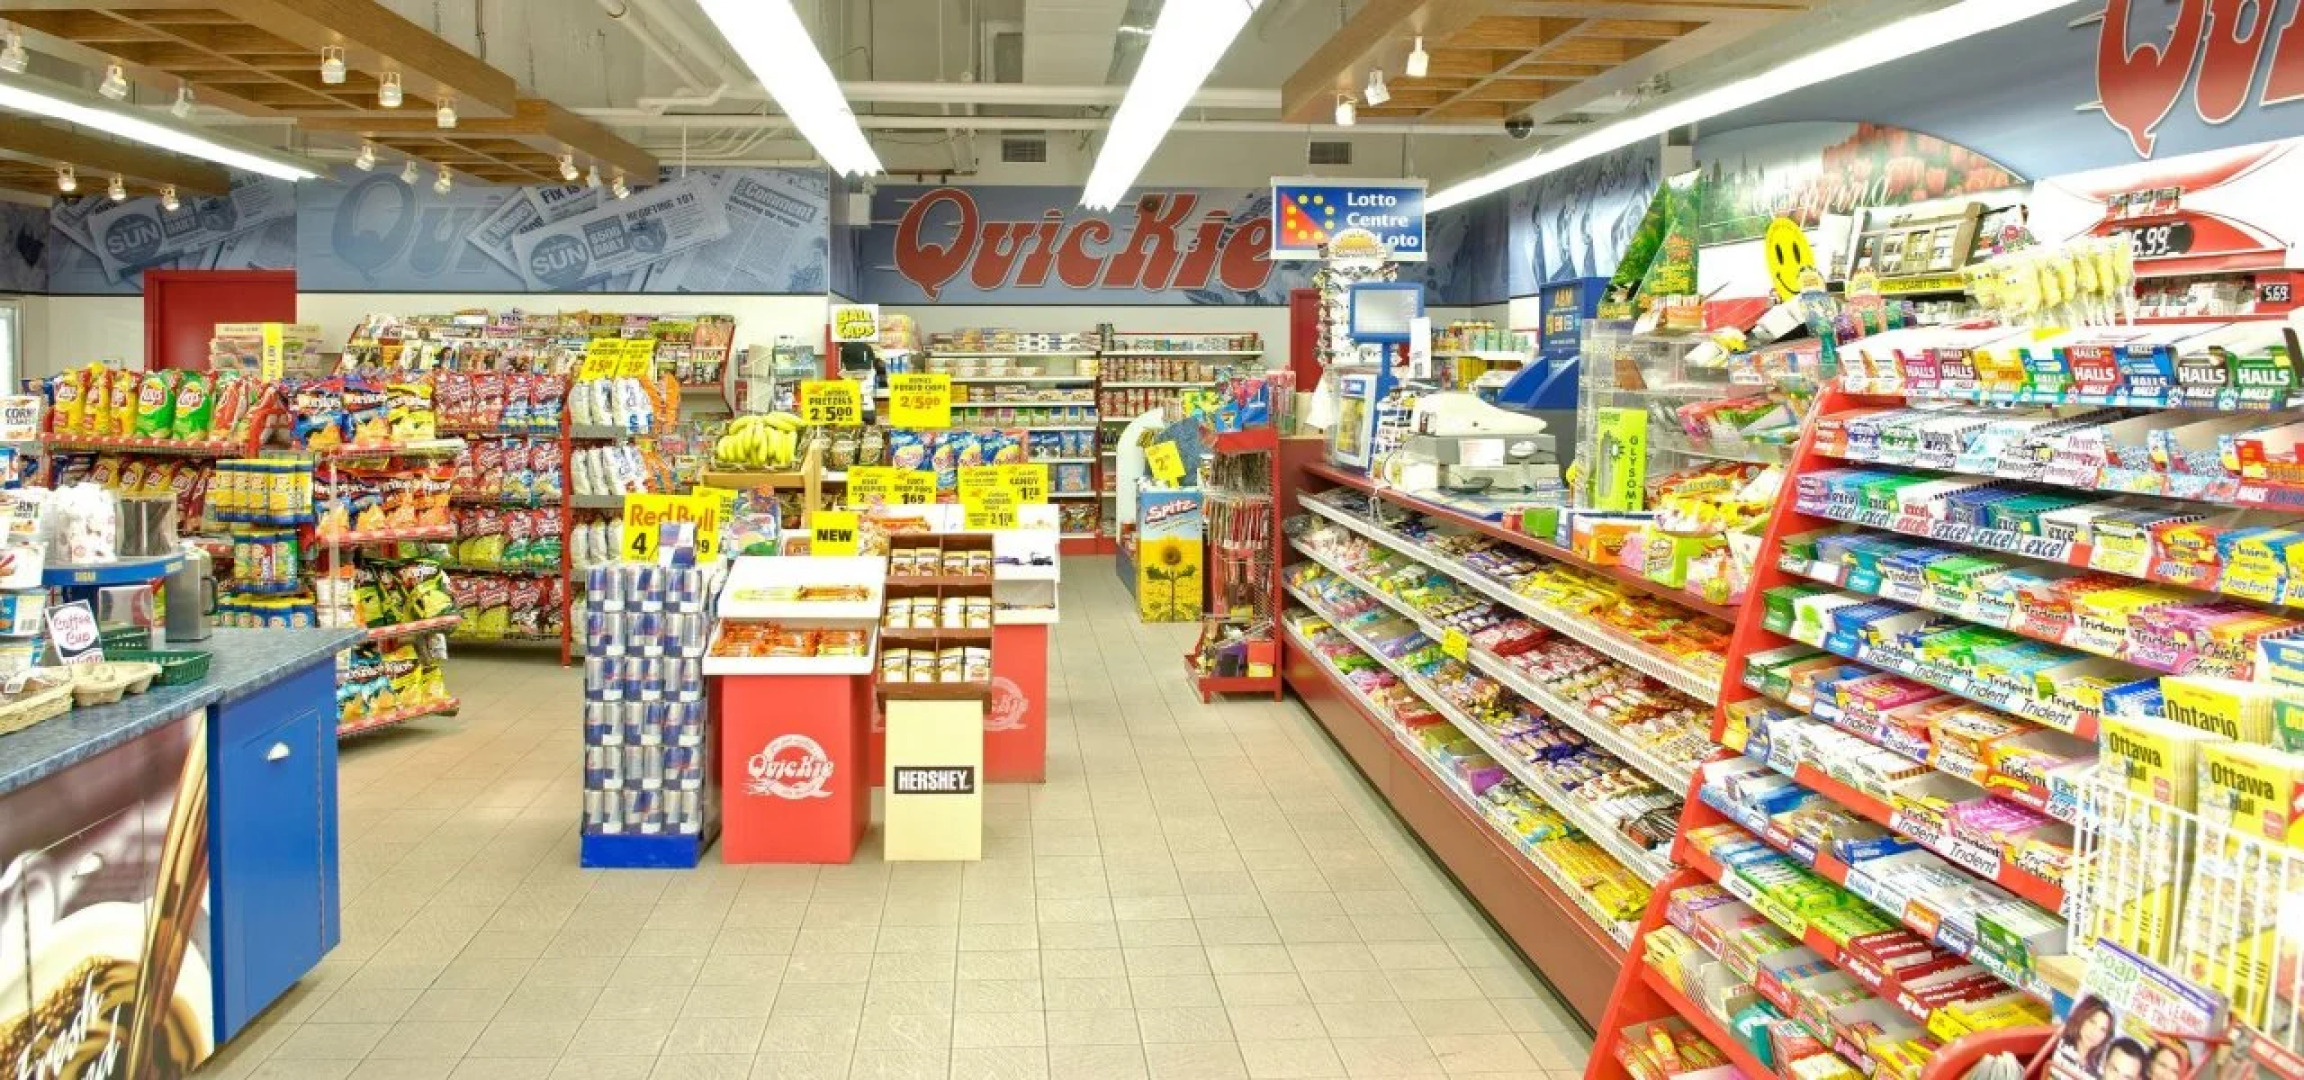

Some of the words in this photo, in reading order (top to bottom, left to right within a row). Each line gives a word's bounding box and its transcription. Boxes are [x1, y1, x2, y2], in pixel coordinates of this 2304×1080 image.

[1347, 192, 1398, 207] Lotto
[1346, 211, 1409, 228] Centre
[107, 224, 160, 252] SUN
[532, 243, 588, 275] SUN
[1906, 365, 1936, 379] HALLS
[1942, 365, 1974, 379] HALLS
[2074, 367, 2116, 381] HALLS
[2130, 377, 2167, 386] HALLS
[2178, 367, 2226, 384] HALLS
[2237, 368, 2290, 385] HALLS
[630, 503, 673, 527] Red
[1144, 498, 1198, 523] Spitz
[1828, 504, 1855, 518] excel
[1861, 511, 1891, 526] excel
[1903, 503, 1930, 517] excel
[816, 529, 853, 543] NEW
[1936, 524, 1971, 541] excel
[1979, 529, 2016, 550] excel
[2025, 537, 2067, 559] excel
[1976, 592, 2015, 610] Trident
[2024, 604, 2071, 621] Trident
[2078, 616, 2127, 637] Trident
[2134, 629, 2188, 651] Trident
[1866, 650, 1903, 668] Trident
[2136, 645, 2175, 664] Trident
[1912, 664, 1953, 685] Trident
[1987, 673, 2034, 697] Trident
[1964, 677, 2010, 705] Trident
[2021, 697, 2073, 727] Trident
[2050, 692, 2101, 718] Trident
[1841, 713, 1877, 734] Trident
[2166, 700, 2239, 742] Ontario
[1886, 734, 1919, 756] Trident
[2109, 732, 2163, 768] Ottawa
[1936, 755, 1974, 777] Trident
[2000, 756, 2046, 788] Trident
[2125, 759, 2147, 782] Hull
[2211, 762, 2275, 801] Ottawa
[2229, 791, 2255, 816] Hull
[1896, 816, 1940, 845] Trident
[1949, 841, 1998, 875] Trident
[2096, 948, 2139, 984] soap
[2086, 968, 2130, 1008] digest
